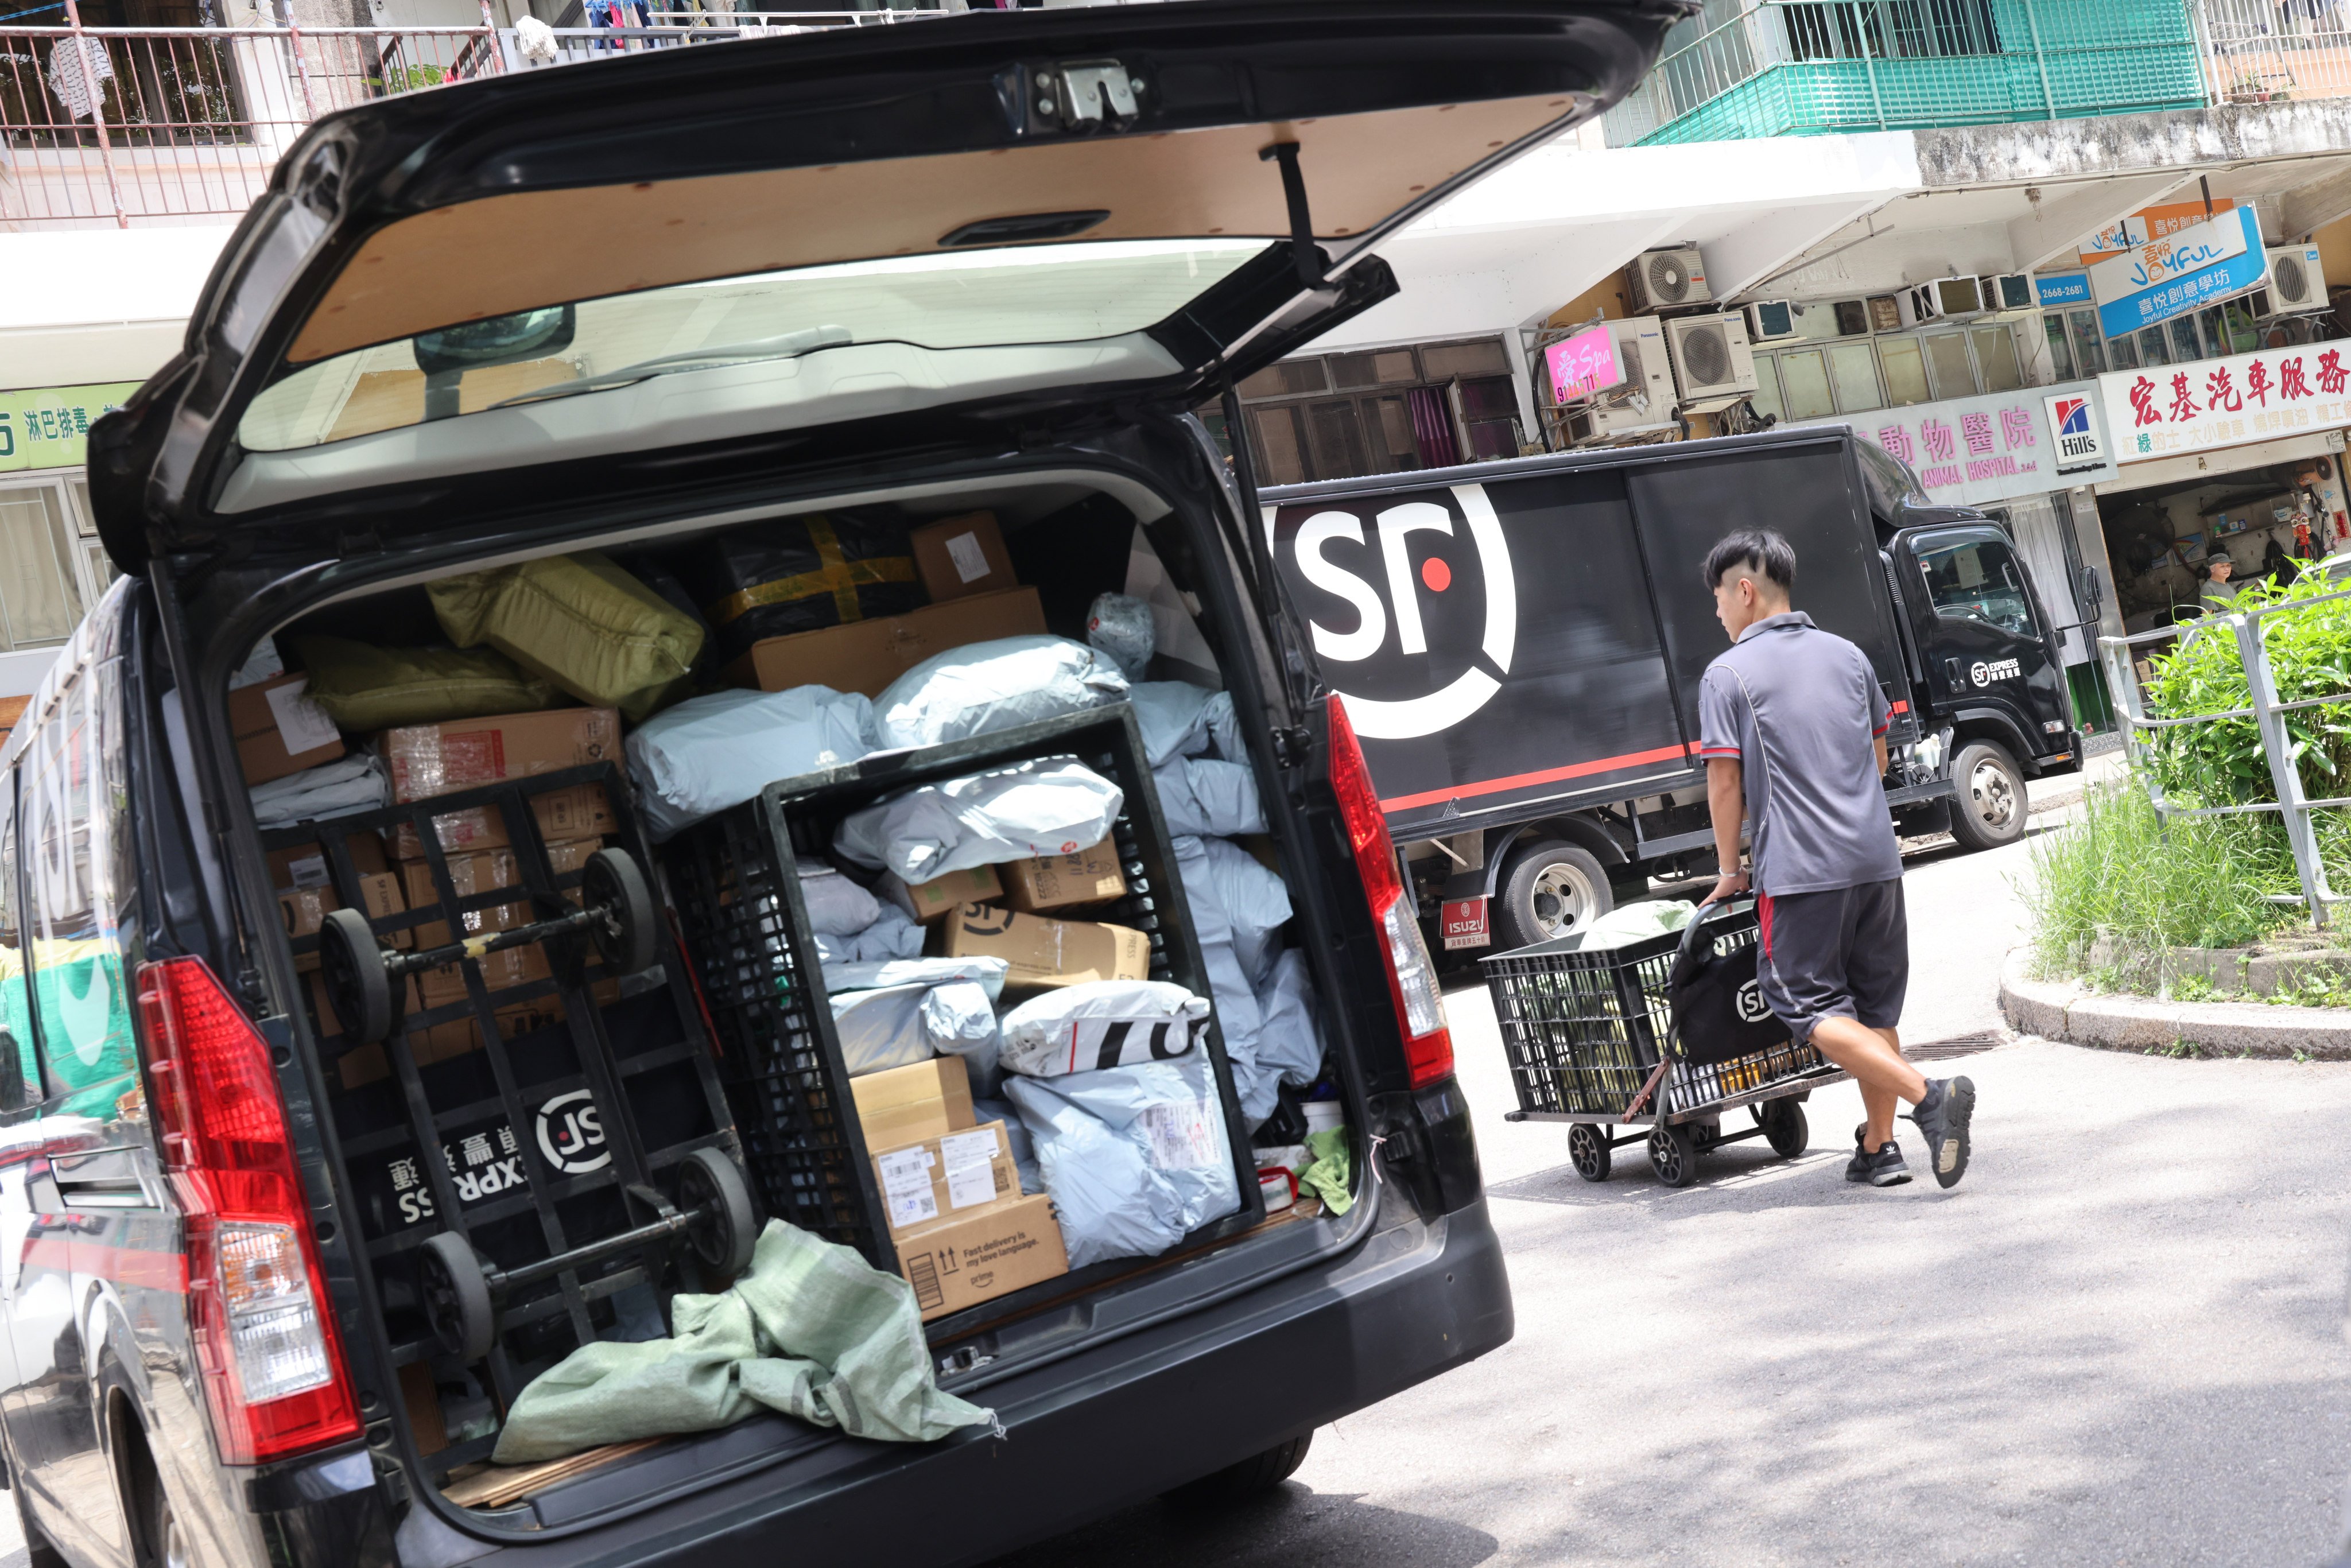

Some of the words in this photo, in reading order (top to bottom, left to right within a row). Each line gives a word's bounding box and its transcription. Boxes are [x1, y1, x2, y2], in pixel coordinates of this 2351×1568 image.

[2131, 245, 2224, 286] JOYFUL
[2043, 285, 2083, 298] 2668-2681
[2142, 312, 2162, 324] Joyful
[2163, 298, 2197, 316] Creativity
[2199, 286, 2232, 302] Academy
[1580, 344, 1611, 379] Spa
[1557, 373, 1601, 402] 91445715
[2129, 349, 2350, 428] 宏基汽車服務
[2061, 436, 2096, 456] Hill's
[1922, 464, 1964, 489] ANIMAL
[1966, 456, 2020, 482] HOSPITAL
[1989, 658, 2019, 672] EXPRESS
[1449, 919, 1484, 934] ISUZU
[963, 1245, 983, 1257] Fast
[983, 1235, 1017, 1251] delivery
[1017, 1231, 1026, 1240] is
[967, 1258, 979, 1267] my
[980, 1252, 998, 1262] love
[998, 1238, 1039, 1256] language.
[970, 1271, 994, 1286] prime
